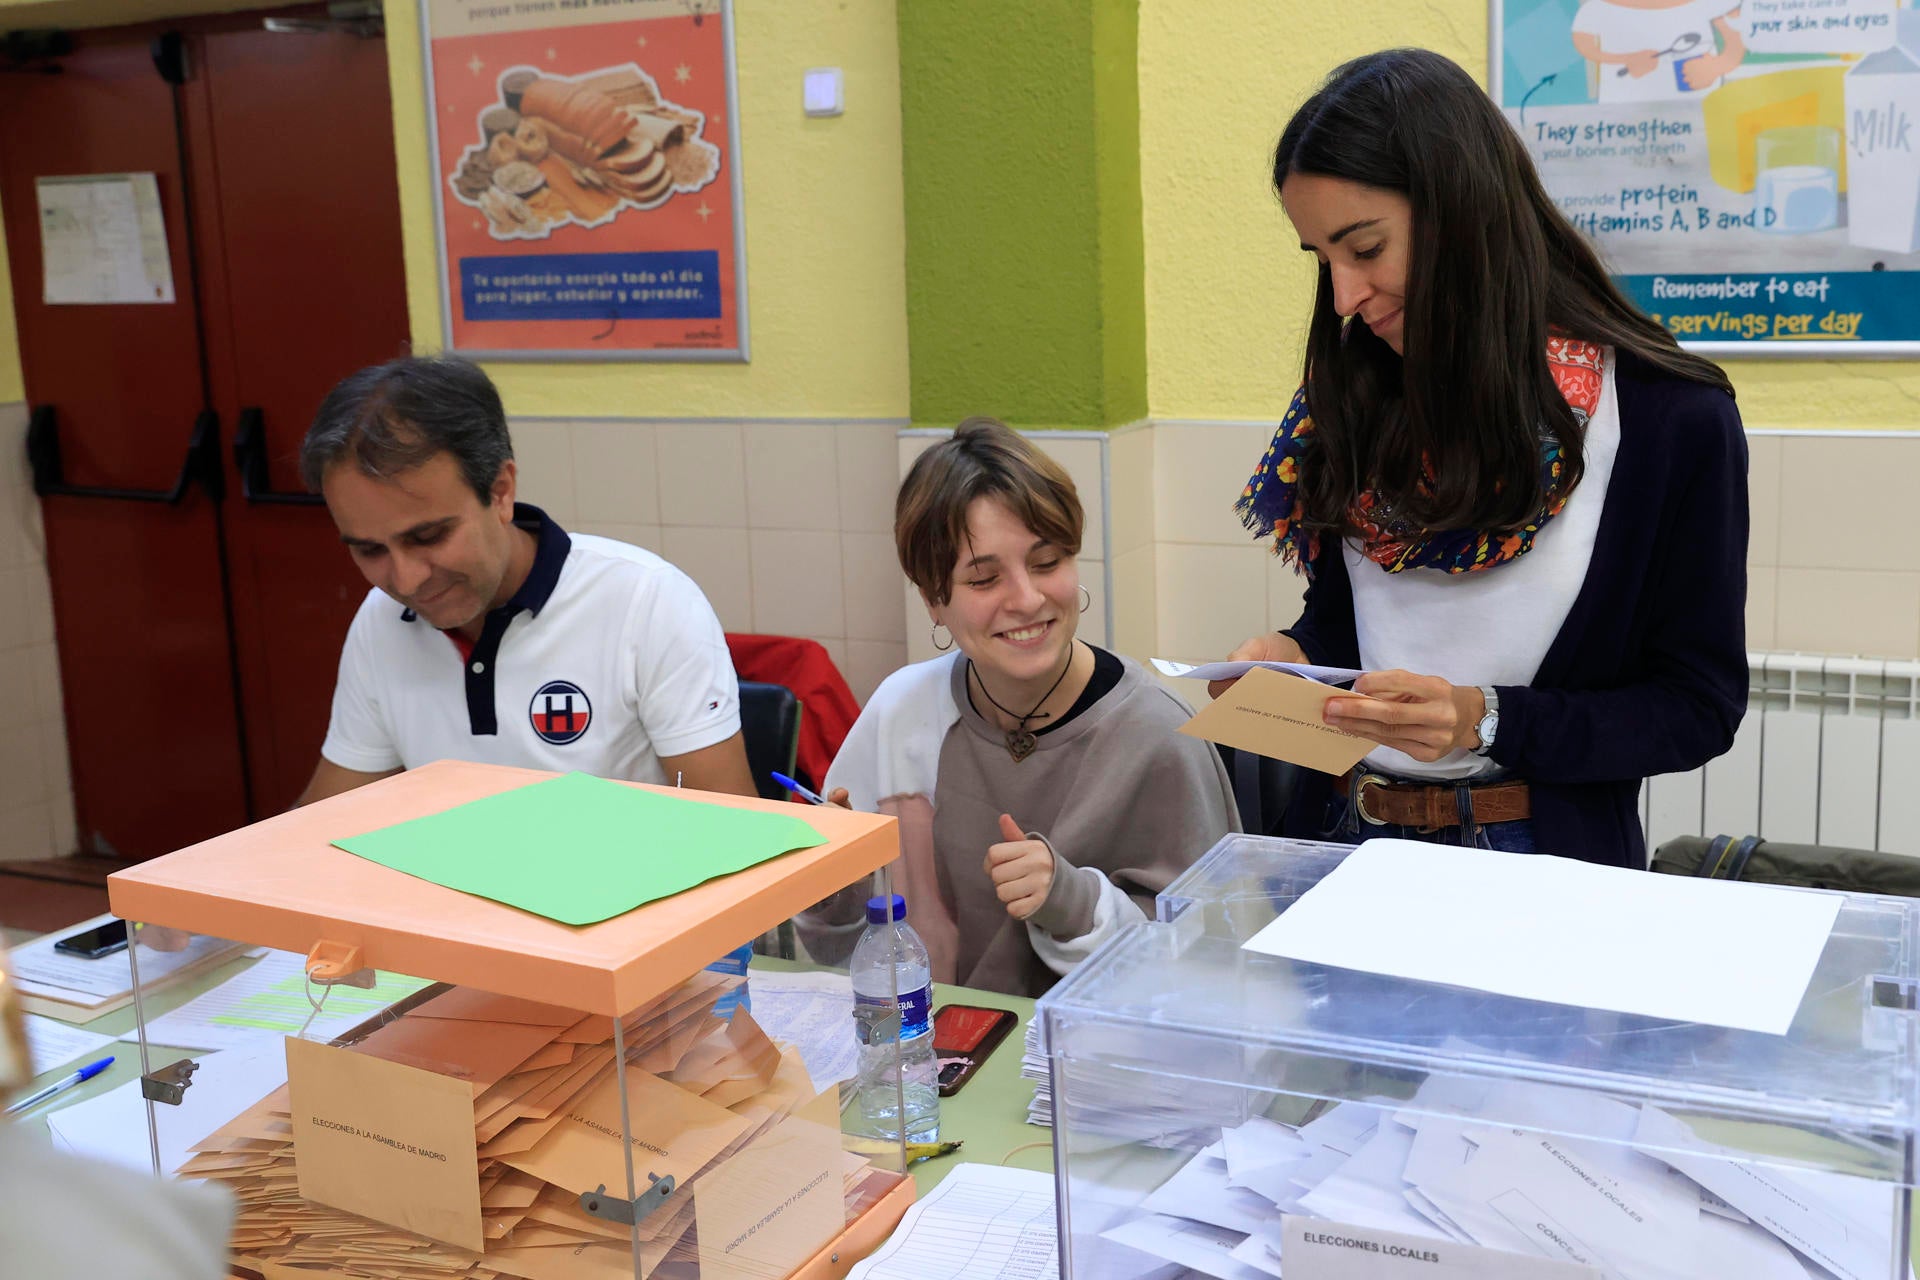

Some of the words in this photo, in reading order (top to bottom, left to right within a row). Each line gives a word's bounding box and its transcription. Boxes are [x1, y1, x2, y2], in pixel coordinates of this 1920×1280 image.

[1750, 20, 1783, 38] your
[1787, 15, 1818, 32] skin
[1822, 15, 1850, 30] and
[1854, 13, 1889, 31] eyes
[1536, 120, 1578, 145] They
[1583, 118, 1693, 143] strengthen
[1851, 101, 1912, 152] Milk
[1542, 145, 1573, 161] your
[1575, 143, 1616, 156] bones
[1619, 142, 1646, 155] and
[1649, 140, 1686, 155] teeth
[1563, 194, 1616, 208] provide
[1619, 184, 1699, 211] protein
[1669, 210, 1690, 233] A,
[1697, 206, 1711, 230] B
[1716, 206, 1757, 228] and
[1762, 206, 1778, 228] D
[1652, 276, 1761, 301] Remember
[1765, 276, 1789, 304] to
[1793, 276, 1831, 304] eat
[1667, 311, 1769, 339] servings
[1773, 313, 1814, 337] per
[1819, 310, 1864, 337] day
[545, 695, 574, 731] H
[312, 1116, 355, 1135] ELECCIONES
[356, 1128, 362, 1137] A
[362, 1129, 372, 1139] LA
[372, 1133, 407, 1151] ASAMBLEA
[407, 1145, 417, 1154] DE
[418, 1148, 447, 1162] MADRID
[573, 1115, 584, 1123] LA
[638, 1141, 669, 1158] MADRID
[1540, 1140, 1599, 1189] ELECCIONES
[1598, 1186, 1644, 1223] LOCALES
[1303, 1232, 1380, 1253] ELECCIONES
[1382, 1244, 1440, 1263] LOCALES
